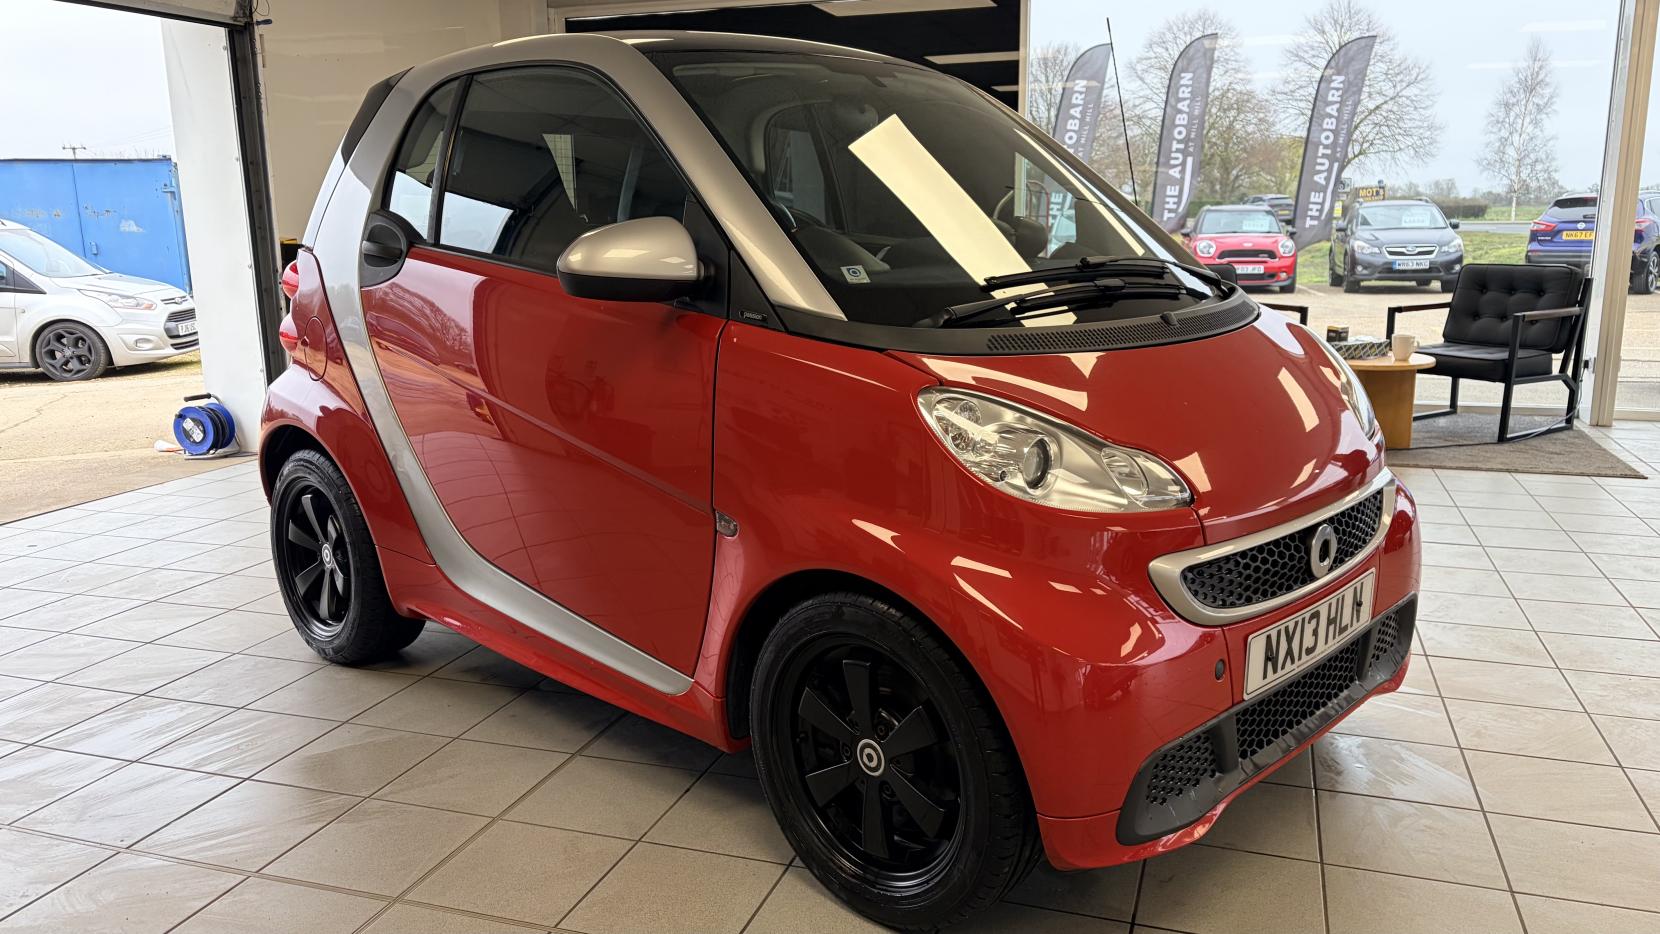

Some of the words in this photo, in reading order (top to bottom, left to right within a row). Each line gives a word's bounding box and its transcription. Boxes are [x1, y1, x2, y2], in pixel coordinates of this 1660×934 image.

[1064, 79, 1087, 153] OBARN
[1168, 72, 1194, 179] AUTOBARN
[1314, 75, 1345, 185] AUTOBARN
[1163, 185, 1180, 221] THE
[1305, 191, 1324, 228] THE
[1262, 609, 1321, 681] NX13
[1324, 581, 1364, 646] HLN
